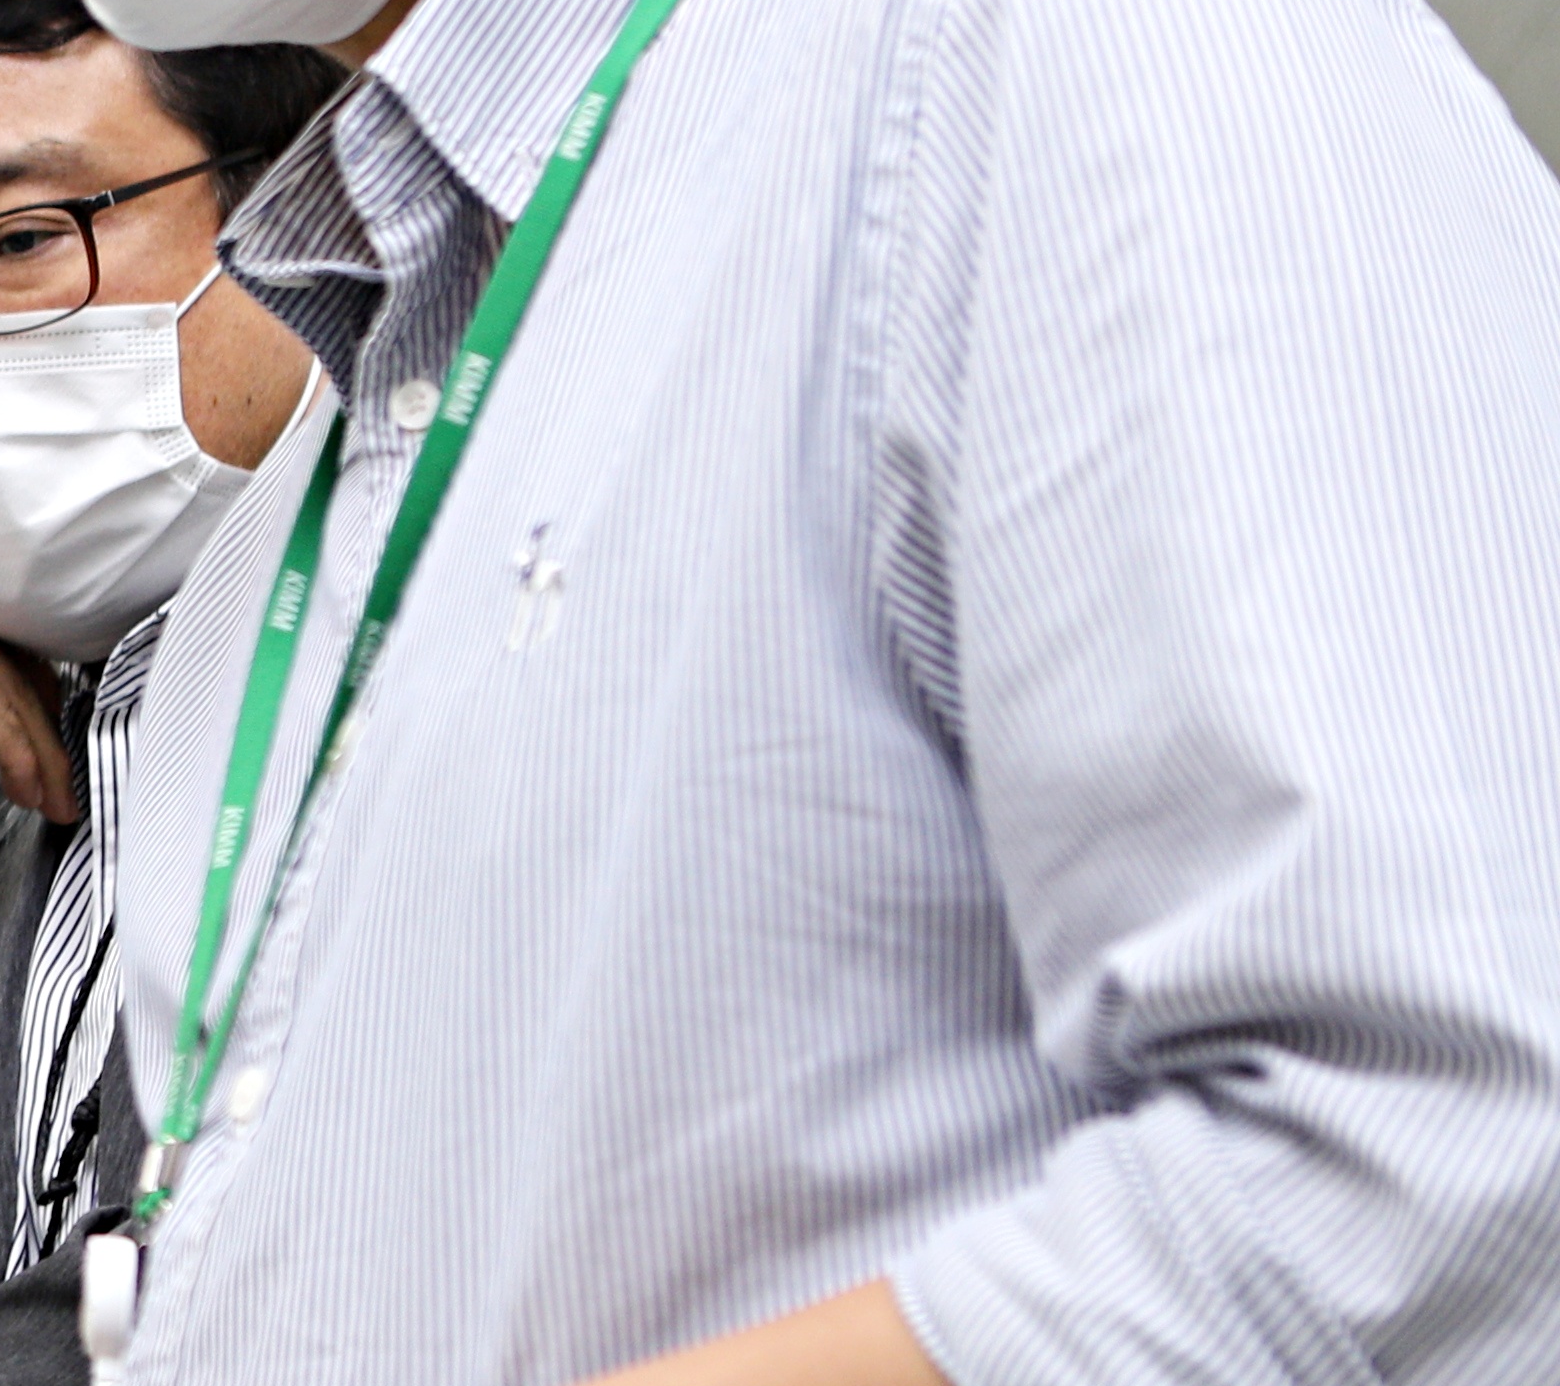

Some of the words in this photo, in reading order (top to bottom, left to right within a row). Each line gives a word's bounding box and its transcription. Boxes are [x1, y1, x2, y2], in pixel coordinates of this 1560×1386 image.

[560, 92, 607, 161] KIMM
[443, 350, 492, 425] KIMM
[271, 569, 308, 632] KIMM
[212, 805, 245, 869] KIMM
